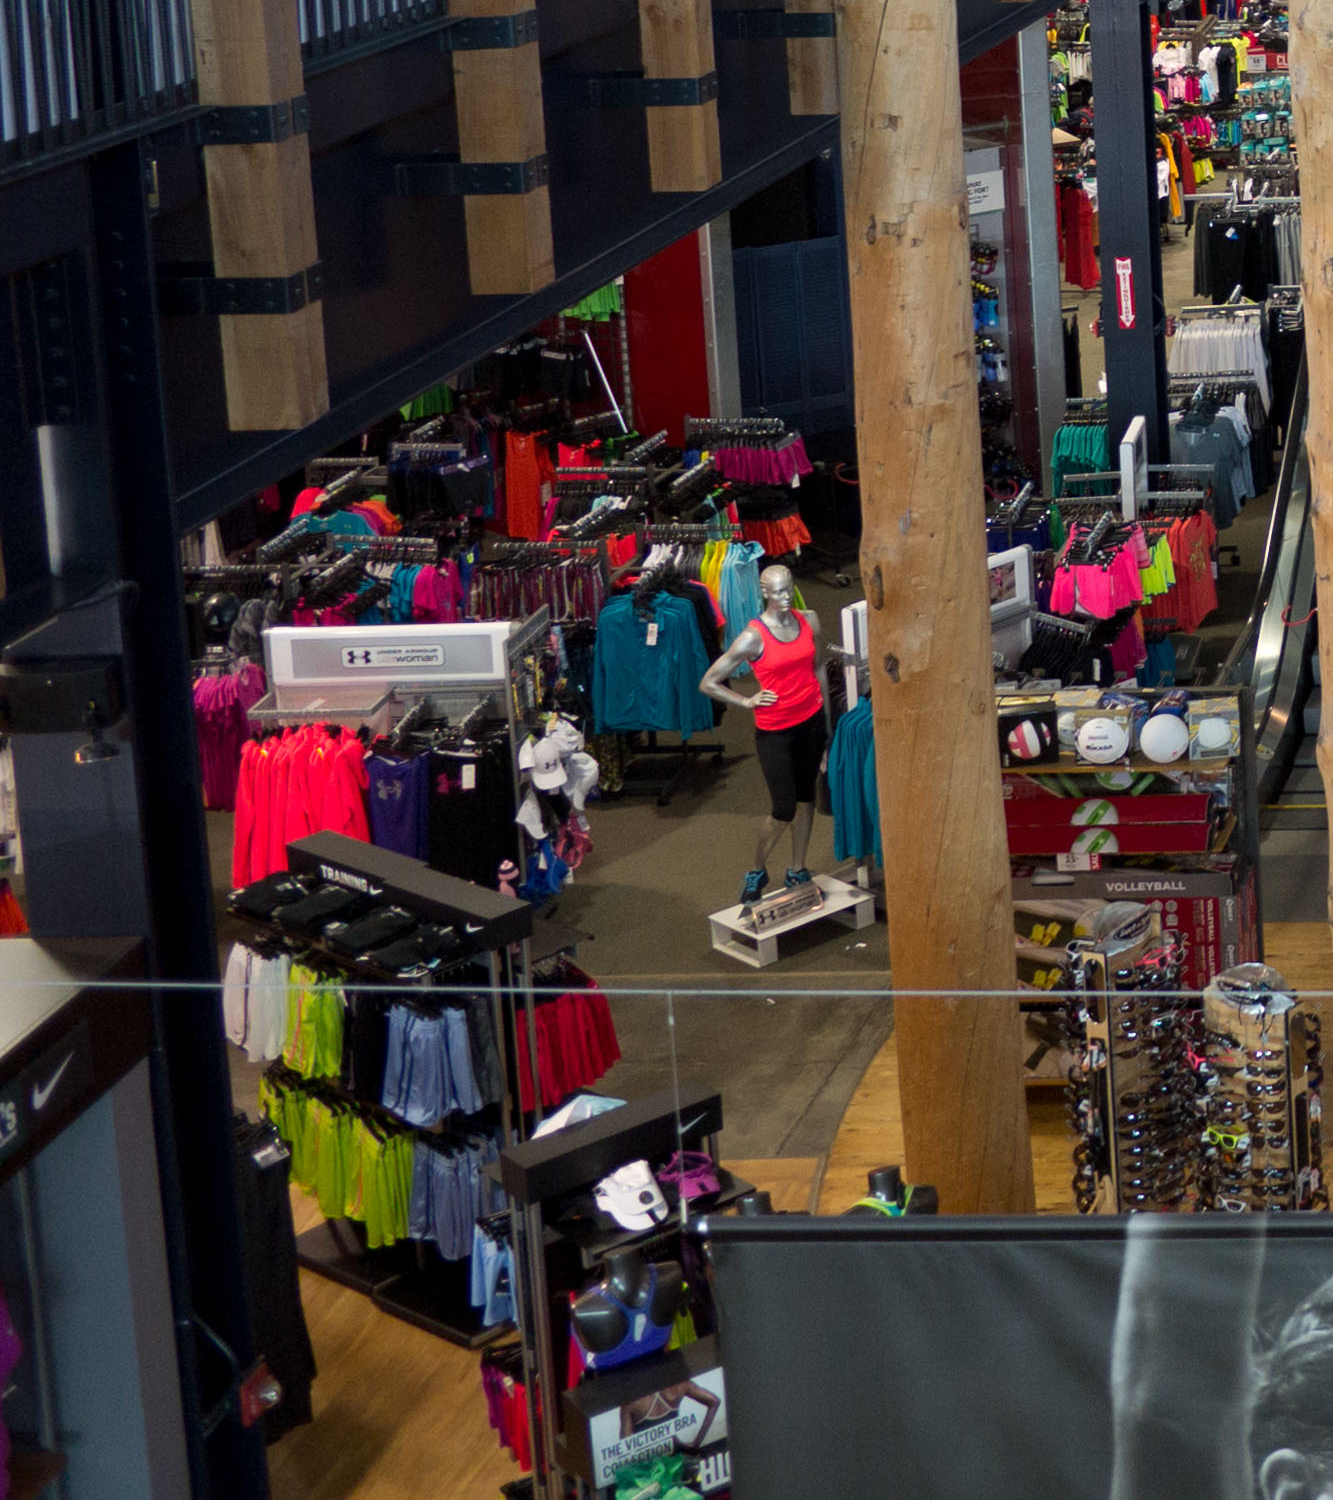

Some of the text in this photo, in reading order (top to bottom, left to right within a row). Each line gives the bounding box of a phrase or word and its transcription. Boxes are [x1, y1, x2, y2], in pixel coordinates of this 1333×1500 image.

[320, 864, 368, 892] TRAINING
[1105, 881, 1186, 892] VOLLEYBALL
[601, 1412, 697, 1461] THE VICTORY BRA
